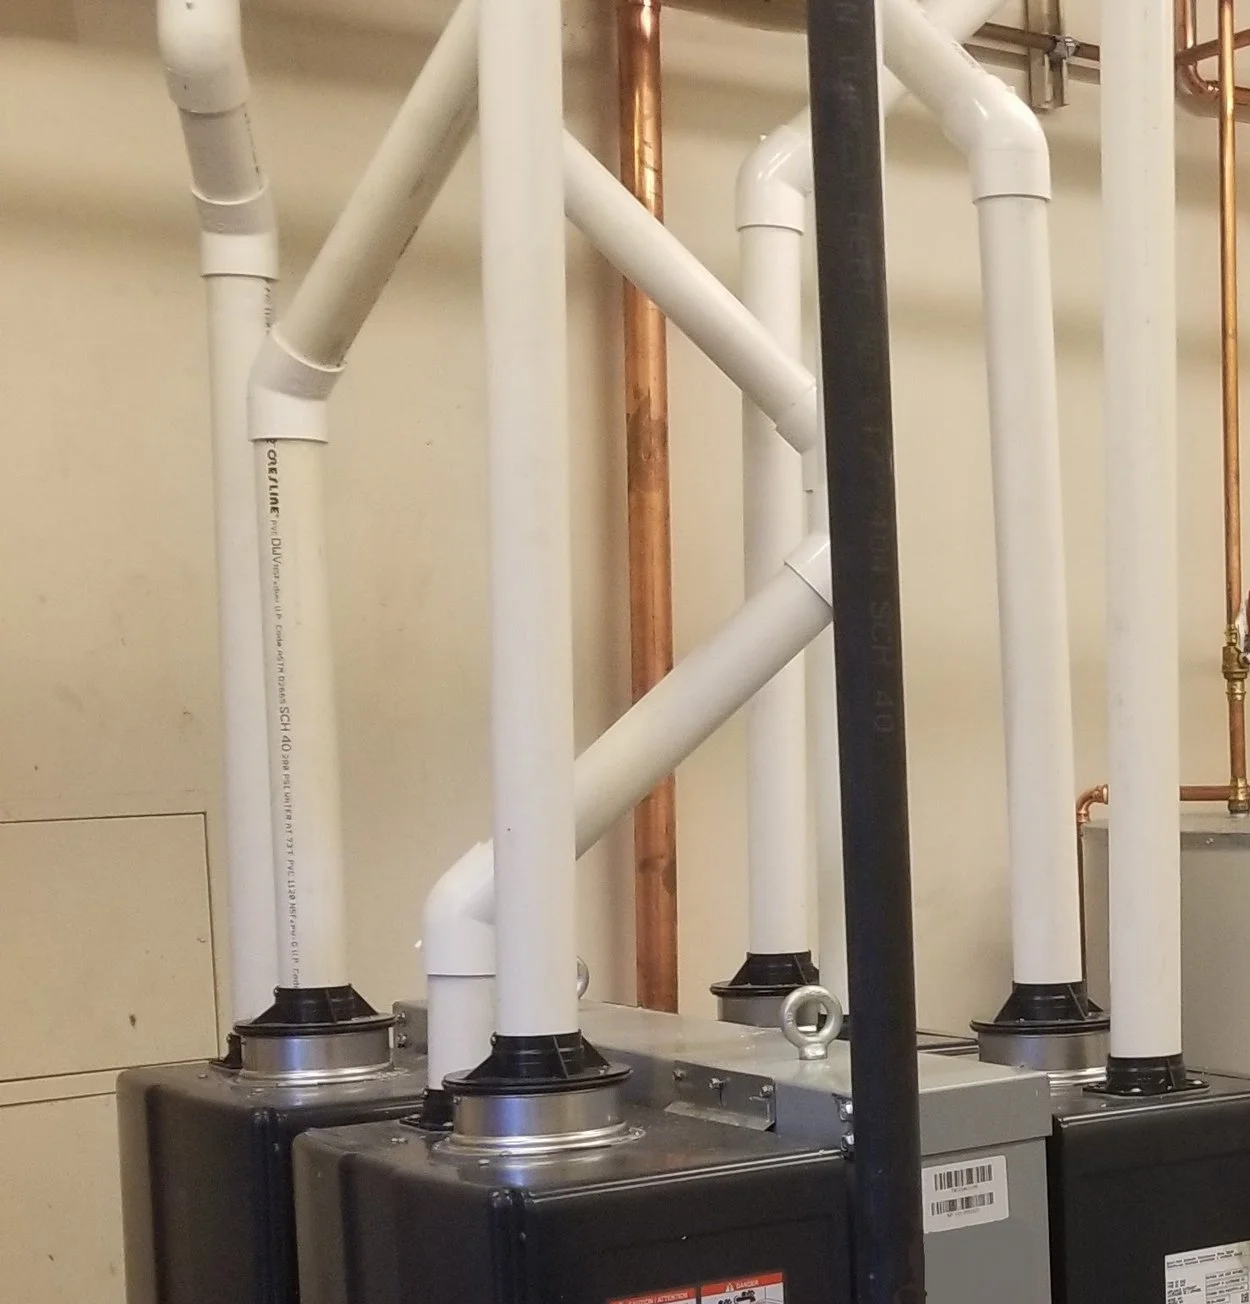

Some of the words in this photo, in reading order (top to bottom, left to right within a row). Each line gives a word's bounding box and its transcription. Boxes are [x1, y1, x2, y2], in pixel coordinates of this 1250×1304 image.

[267, 449, 280, 514] CRESLINE
[271, 537, 282, 565] DWV
[869, 600, 894, 667] SCH
[279, 706, 291, 732] SCH
[872, 689, 896, 734] 40
[281, 735, 292, 752] 40
[736, 1279, 758, 1288] DANGER
